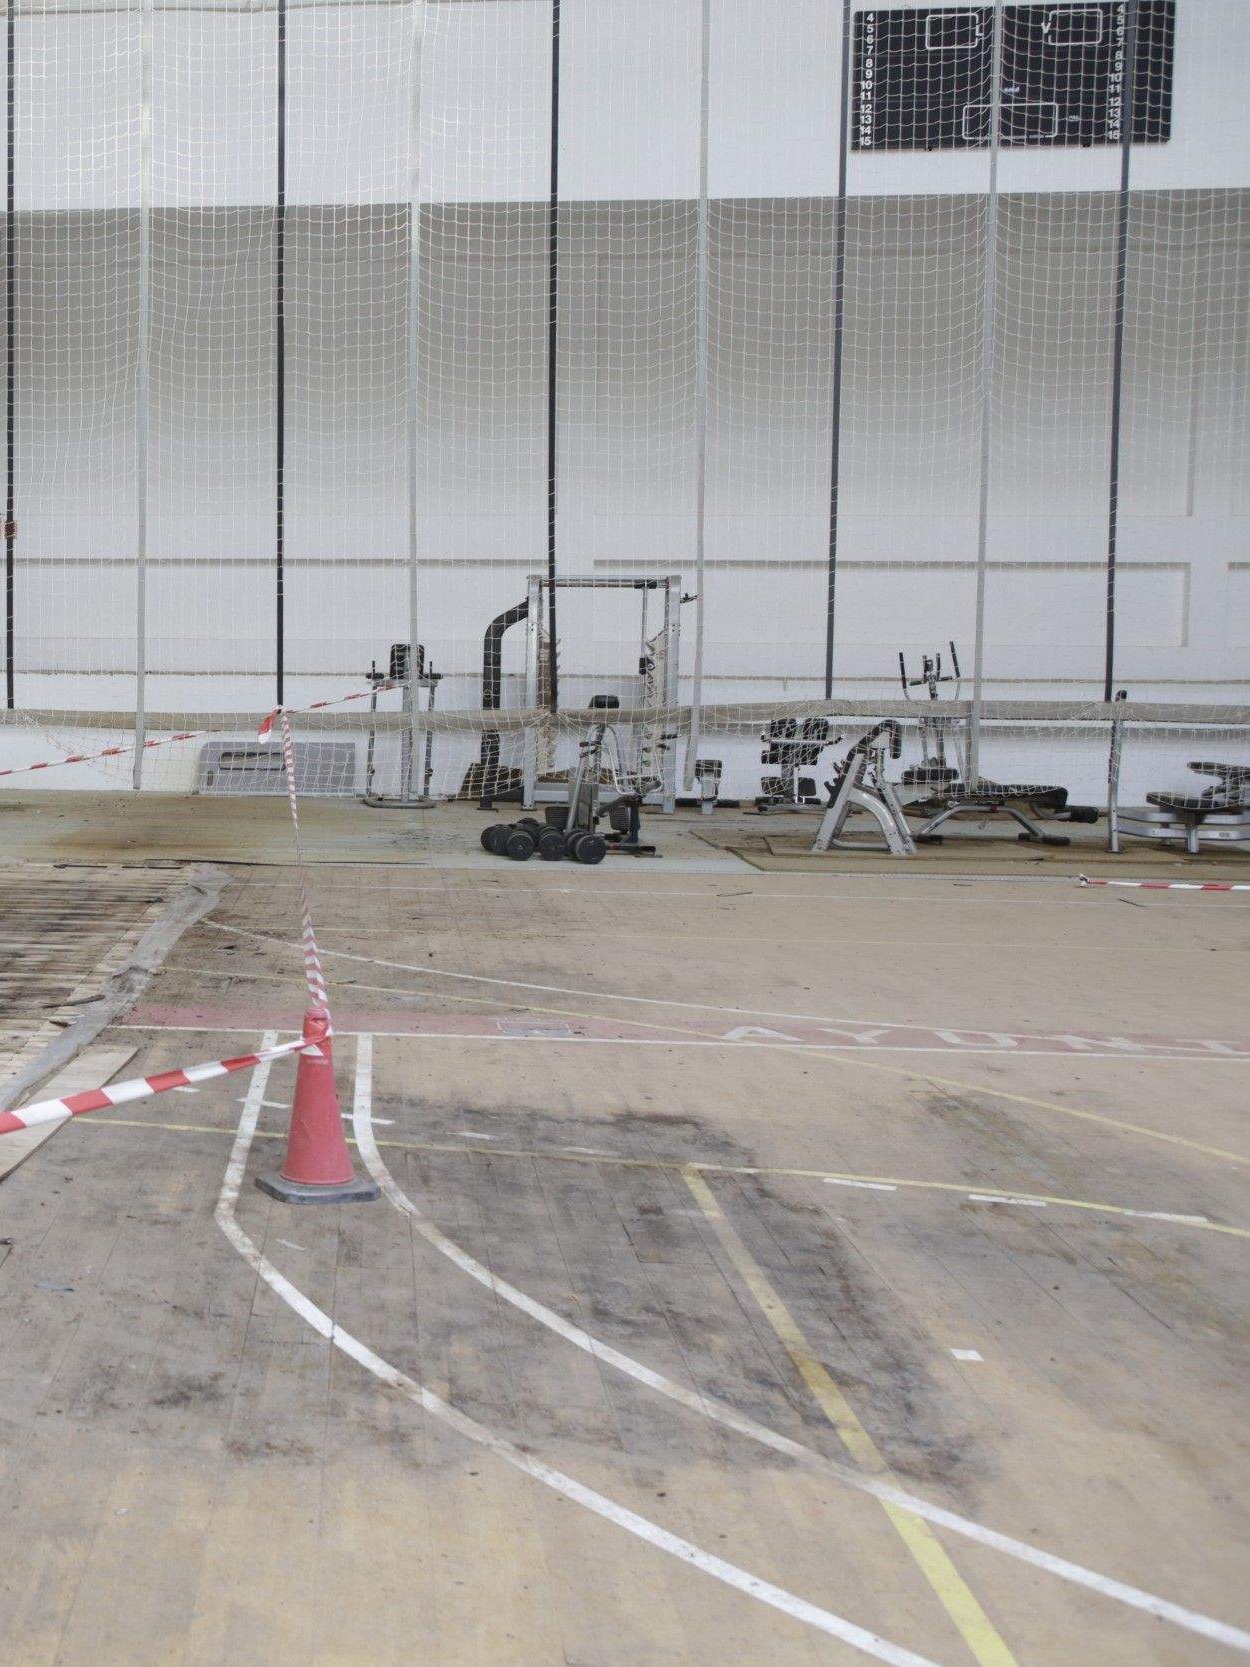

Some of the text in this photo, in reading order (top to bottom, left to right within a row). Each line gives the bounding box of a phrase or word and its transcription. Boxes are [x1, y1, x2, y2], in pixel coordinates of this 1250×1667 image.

[866, 12, 874, 22] 4
[866, 24, 874, 34] 5
[1040, 22, 1051, 34] V
[866, 35, 874, 44] 6
[866, 45, 874, 55] 7
[865, 58, 873, 68] 8
[865, 69, 873, 79] 9
[860, 80, 873, 90] 10
[1109, 84, 1121, 94] 11
[860, 91, 872, 101] 11
[1108, 97, 1121, 107] 12
[860, 104, 873, 114] 12
[860, 115, 872, 125] 13
[860, 125, 872, 135] 14
[859, 136, 872, 146] 15
